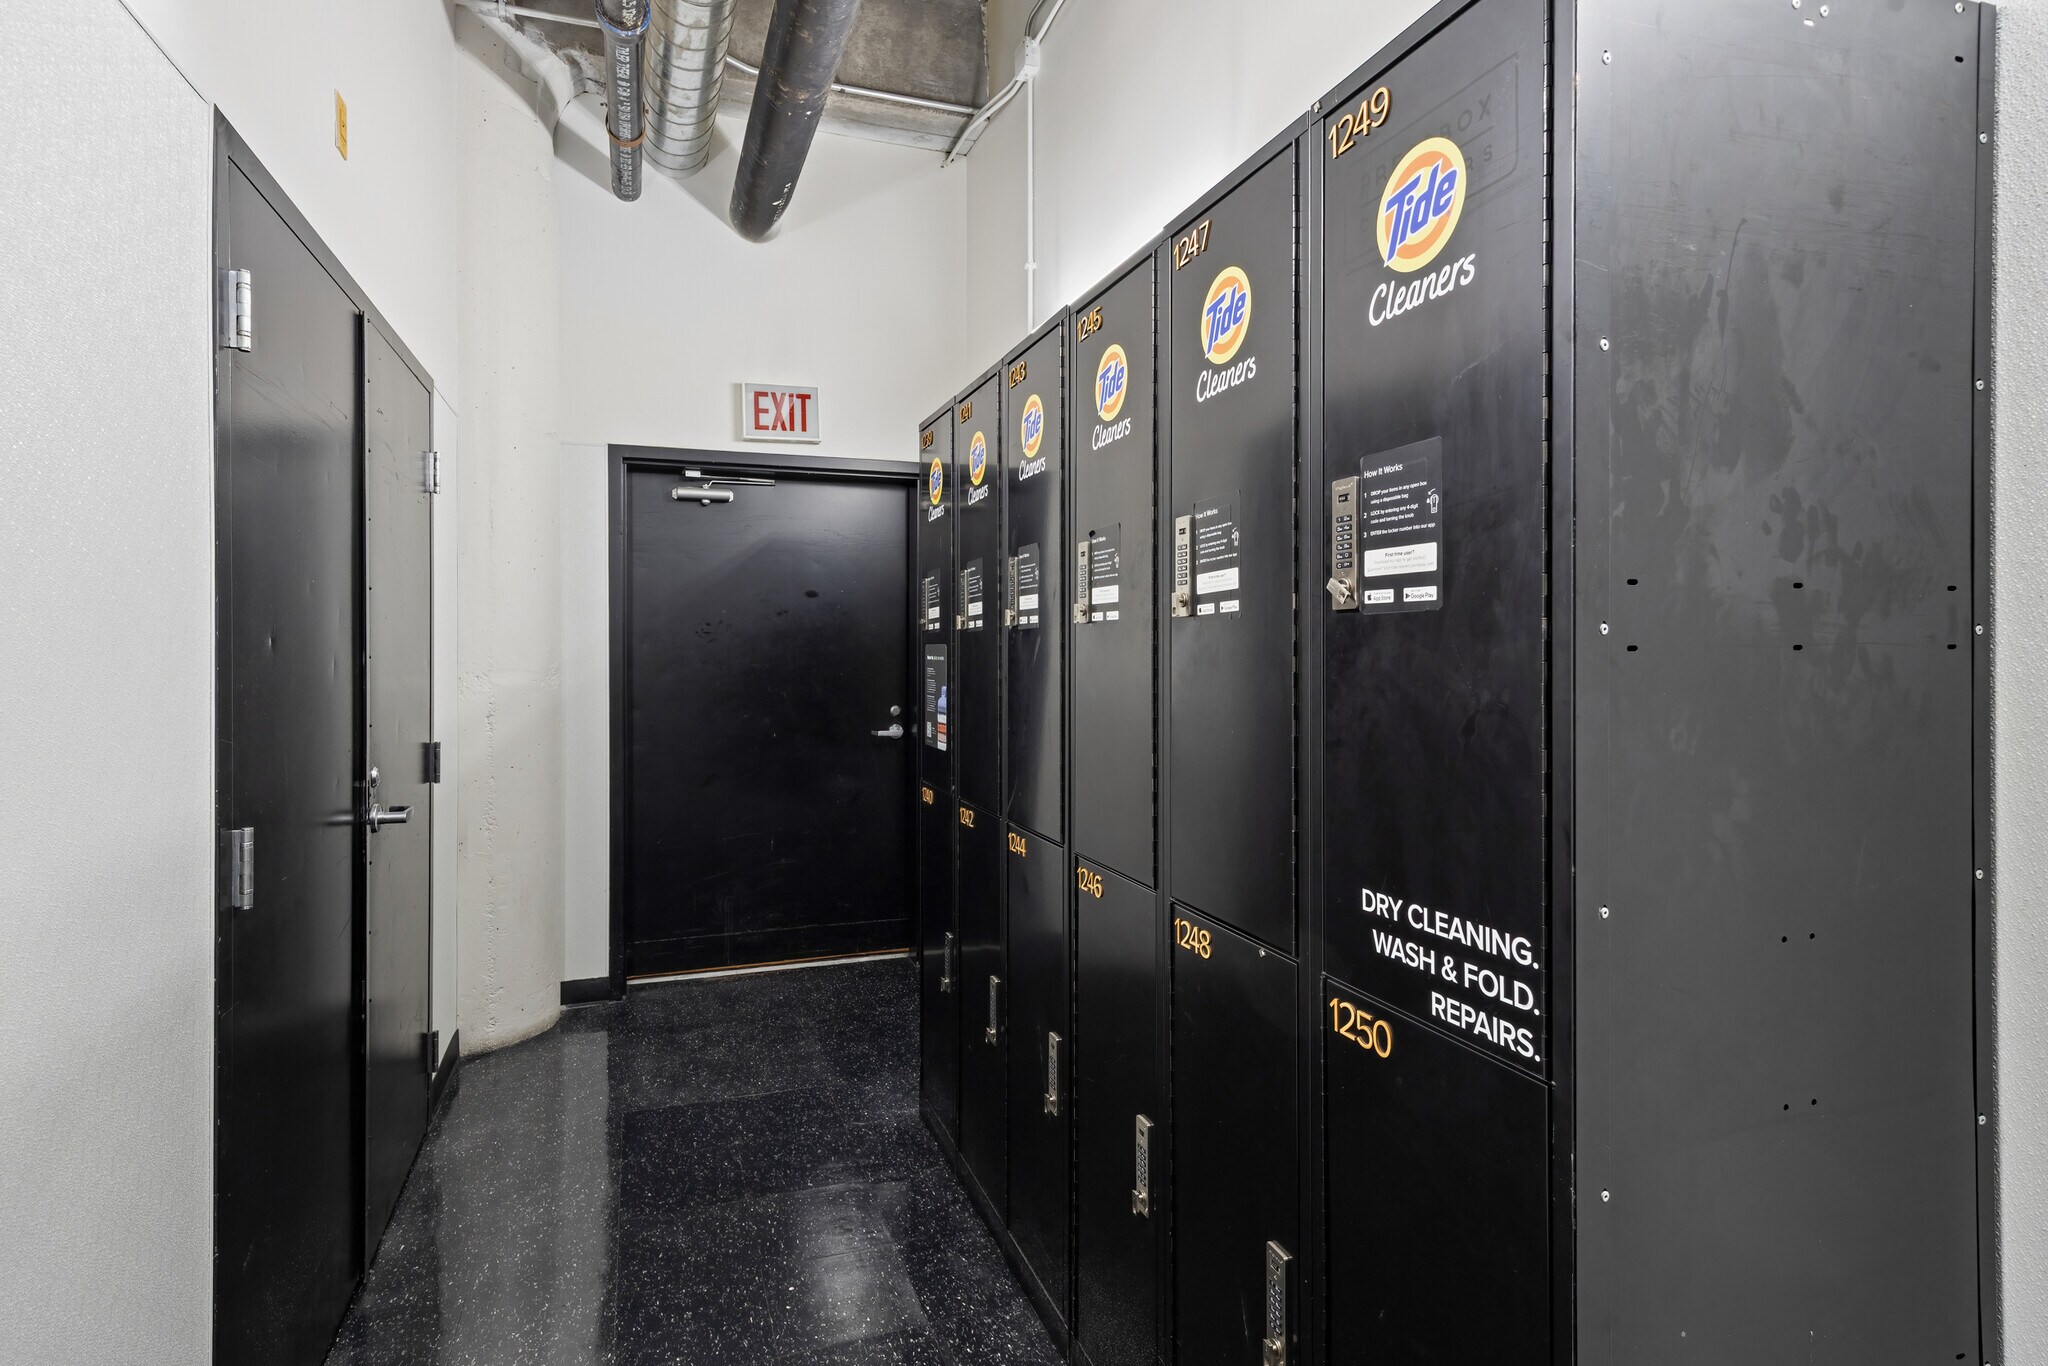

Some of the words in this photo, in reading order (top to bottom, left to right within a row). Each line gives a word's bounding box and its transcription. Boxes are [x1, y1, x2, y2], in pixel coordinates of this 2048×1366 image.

[1328, 86, 1392, 159] 1249
[1383, 157, 1459, 268] Tide
[1173, 219, 1213, 271] 1247
[1368, 253, 1476, 327] Cleaners
[1077, 305, 1103, 343] 1245
[1204, 283, 1248, 359] Tide
[1009, 361, 1027, 389] 1243
[1097, 358, 1126, 416] Tide
[1196, 355, 1257, 403] Cleaners
[753, 391, 812, 432] EXIT
[1022, 406, 1042, 452] Tide
[1092, 417, 1131, 451] Cleaners
[970, 442, 985, 481] Tide
[1018, 456, 1046, 482] Cleaners
[1363, 470, 1377, 478] How
[1383, 463, 1403, 474] Works
[930, 467, 942, 500] Tide
[967, 484, 989, 506] Cleaners
[959, 806, 975, 828] 1242
[1007, 832, 1026, 857] 1244
[1076, 866, 1104, 899] 1246
[1174, 917, 1212, 960] 1248
[1361, 888, 1403, 922] DRY
[1407, 903, 1539, 970] CLEANING.
[1372, 928, 1435, 975] WASH
[1441, 954, 1458, 984] &
[1464, 961, 1540, 1016] FOLD.
[1329, 997, 1393, 1059] 1250
[1431, 991, 1541, 1062] REPAIRS.
